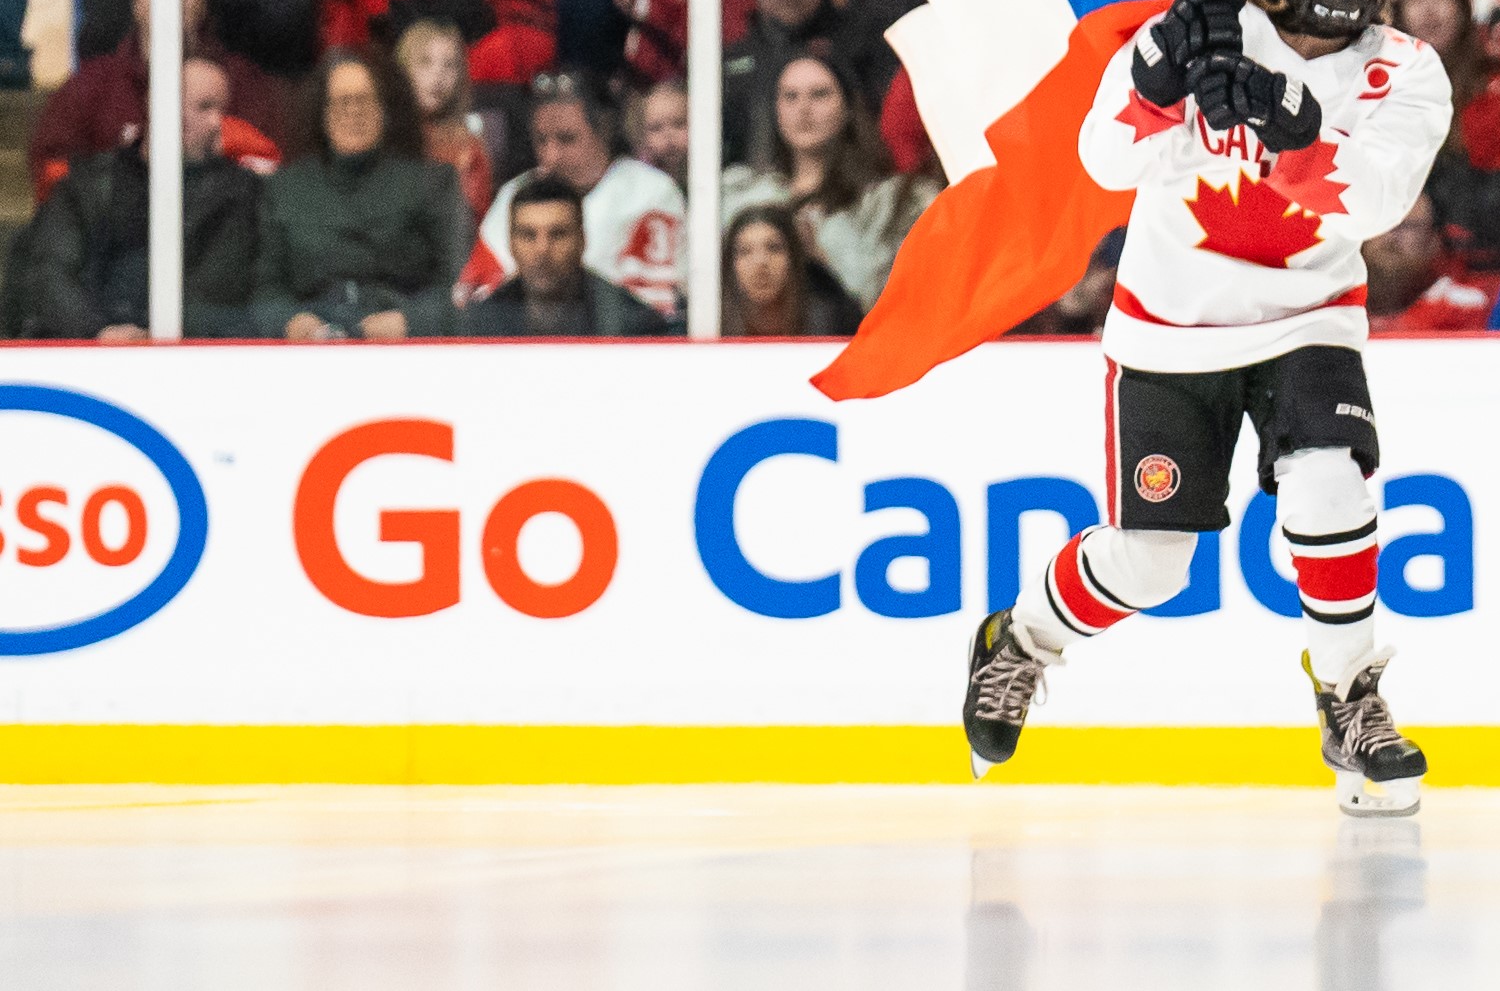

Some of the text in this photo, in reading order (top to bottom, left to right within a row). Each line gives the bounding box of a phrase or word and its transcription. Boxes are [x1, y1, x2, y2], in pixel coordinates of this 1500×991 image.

[1196, 110, 1266, 164] CA
[0, 486, 148, 568] so
[293, 419, 619, 620] Go
